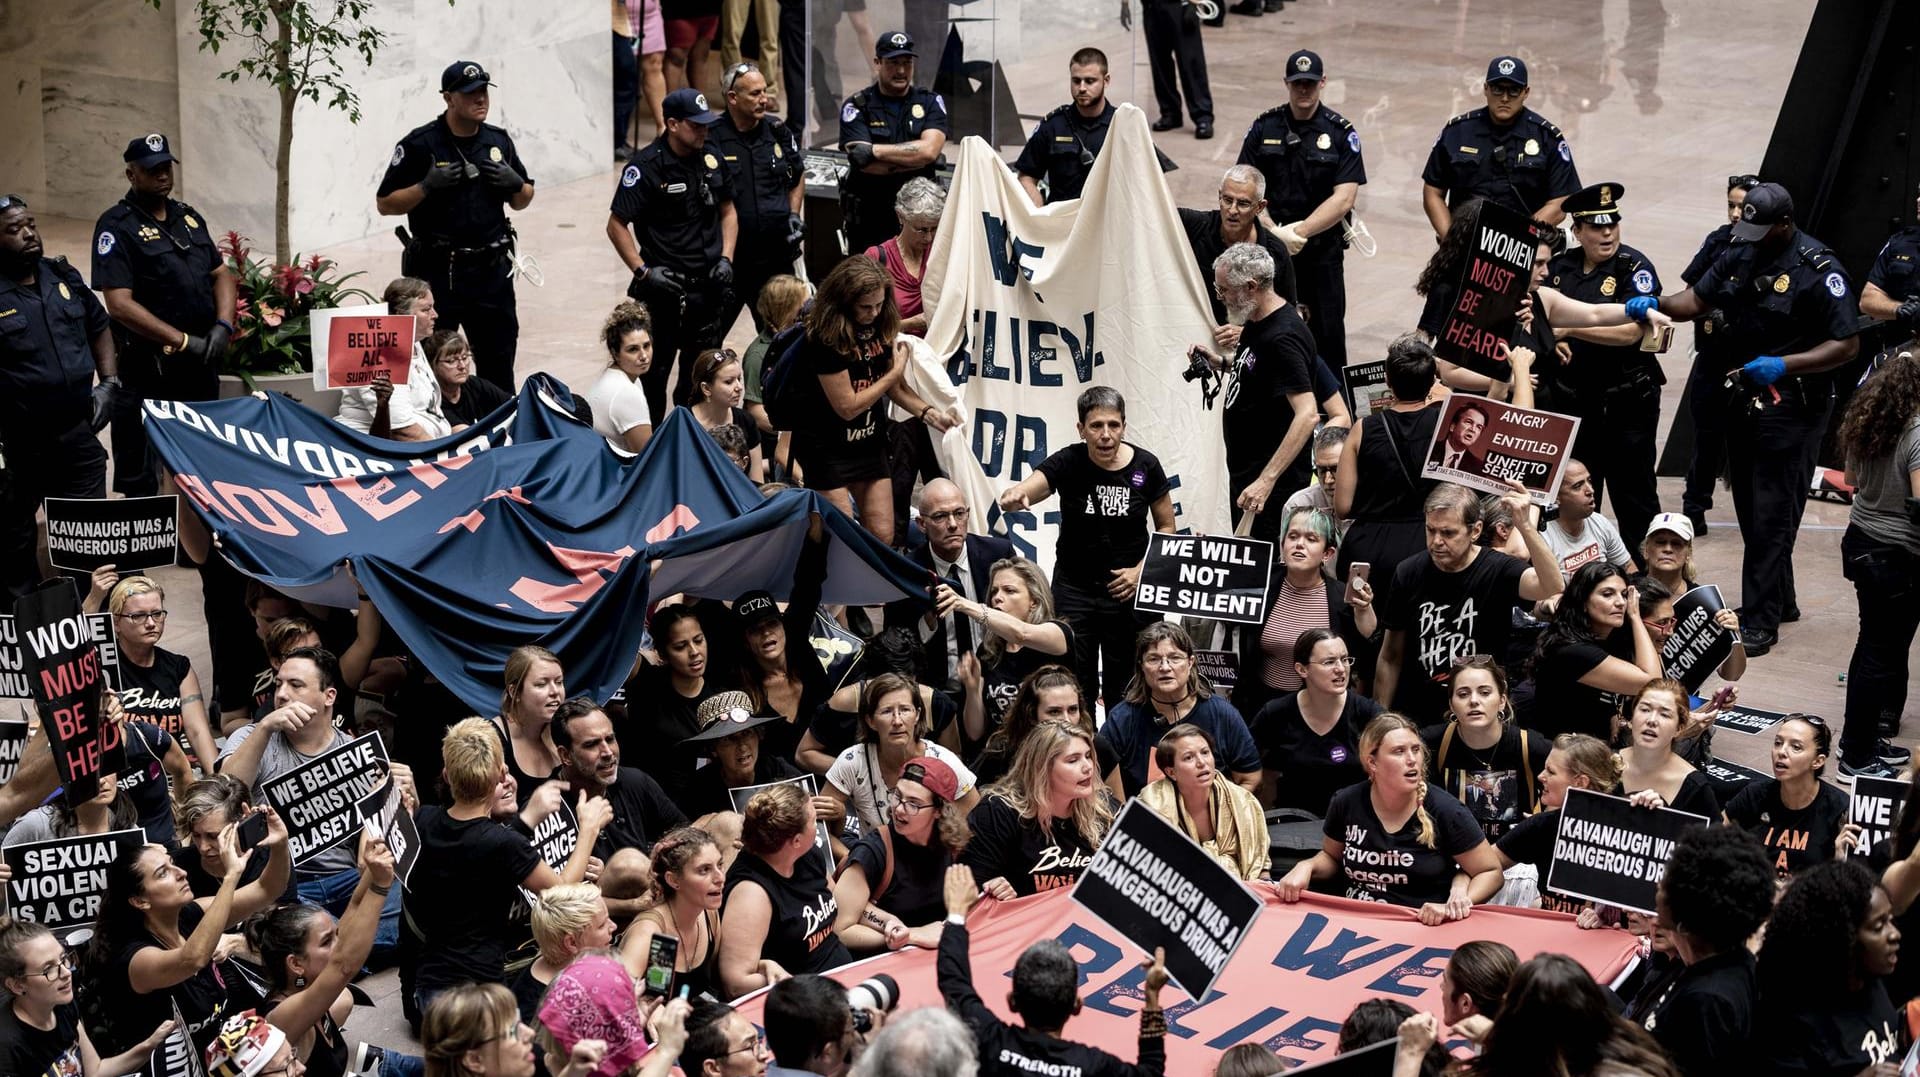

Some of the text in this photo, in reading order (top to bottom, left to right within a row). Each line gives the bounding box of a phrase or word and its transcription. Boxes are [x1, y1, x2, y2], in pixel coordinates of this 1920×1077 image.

[1480, 226, 1534, 271] WOMEN
[1470, 258, 1515, 294] MUST
[1459, 289, 1482, 316] BE
[366, 319, 382, 330] WE
[348, 332, 398, 348] BELIEVE
[1446, 319, 1508, 361] HEARD
[361, 349, 383, 367] ALL
[1360, 364, 1384, 375] BELIEVE
[1500, 410, 1548, 429] ANGRY
[1492, 433, 1558, 456] ENTITLED
[1437, 467, 1449, 476] TAKE
[1449, 469, 1464, 480] ACTION
[1483, 478, 1494, 487] BACK
[1482, 463, 1525, 481] SERVE
[1486, 452, 1547, 475] UNFIT TO
[1095, 485, 1130, 497] OMEN
[50, 517, 174, 538] KAVANAUGH WAS A
[50, 533, 175, 555] DANGEROUS DRUNK
[1161, 540, 1256, 566] WE WILL
[1565, 545, 1599, 568] DISSENT IS
[1179, 563, 1230, 588] NOT
[739, 597, 773, 616] CTZN
[1138, 584, 1262, 616] BE SILENT
[1419, 597, 1478, 638] BE A
[26, 612, 91, 660] WOM
[1663, 605, 1708, 659] OUR LIVES
[1197, 653, 1227, 665] ELIEVE
[1418, 631, 1476, 678] HERO
[1667, 662, 1685, 683] RE
[1679, 647, 1698, 670] ON
[1690, 628, 1716, 655] THE
[40, 647, 100, 700] MUST
[1198, 665, 1238, 680] RVIVORS.
[53, 701, 89, 741] BE
[117, 769, 145, 791] SIST
[271, 742, 376, 807] WE BELIEVE
[289, 769, 378, 827] CHRISTINE
[1855, 795, 1892, 826] WE
[288, 810, 351, 858] BLASEY
[1346, 824, 1368, 845] My
[1491, 824, 1500, 835] ME
[1562, 817, 1676, 861] KAVANAUGH WA
[1764, 827, 1809, 851] I AM
[1028, 846, 1094, 874] Belie
[1556, 840, 1643, 879] DANGEROUS
[1775, 850, 1788, 870] A
[12, 868, 108, 902] VIOLEN
[1108, 829, 1204, 913] KAVANAUGH
[1197, 898, 1230, 938] WAS
[1222, 926, 1239, 950] A
[12, 904, 36, 924] IS
[44, 903, 61, 923] A
[802, 894, 838, 941] Belie
[1091, 851, 1229, 974] DANGEROUS DRUNK
[1271, 913, 1453, 996] WE
[1000, 1050, 1081, 1077] STRENGTH
